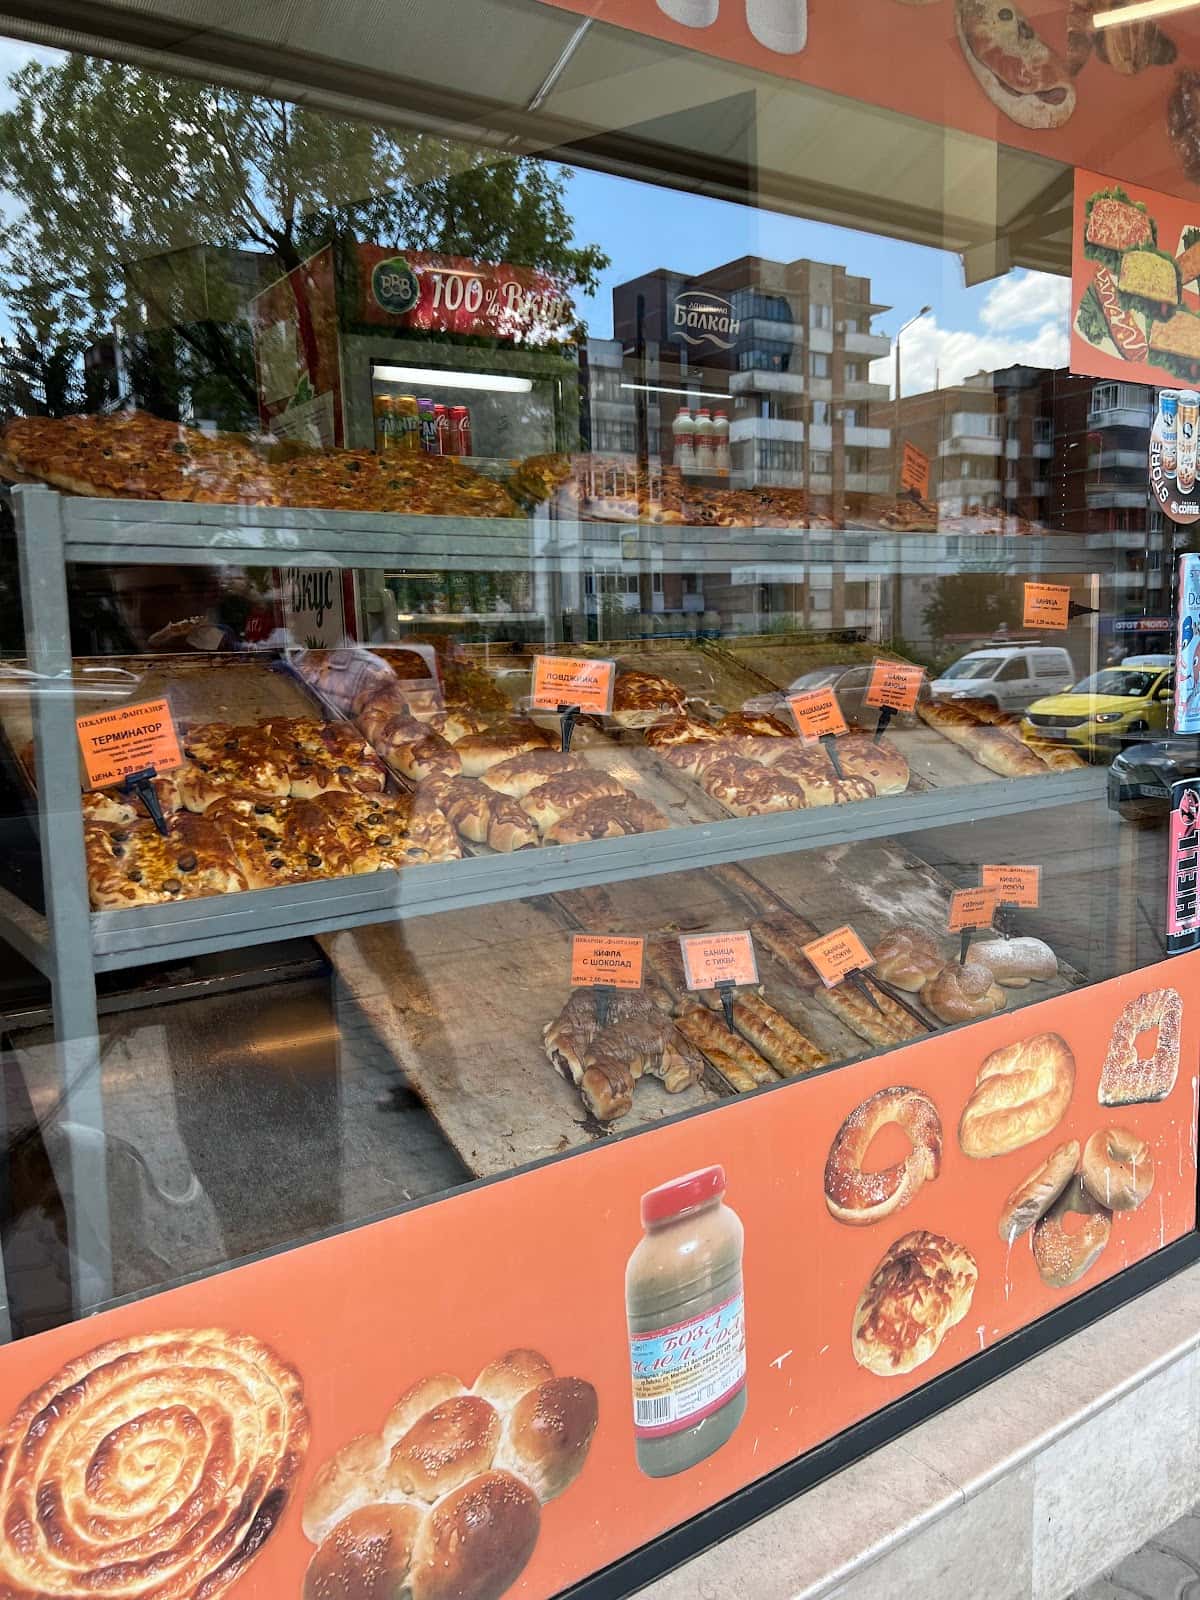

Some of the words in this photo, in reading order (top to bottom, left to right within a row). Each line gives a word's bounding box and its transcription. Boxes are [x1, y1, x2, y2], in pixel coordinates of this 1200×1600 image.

[673, 303, 740, 334] Балкан
[1151, 442, 1169, 502] STORE
[78, 714, 117, 728] ПЕКАРНИ
[91, 722, 162, 746] ТЕРМИНАТОР
[1175, 829, 1200, 922] HELL
[593, 949, 622, 958] КИФЛА
[703, 948, 735, 957] БАНИЦА
[712, 957, 736, 966] ТИКВА
[582, 958, 589, 966] С
[590, 959, 632, 969] ШОКОЛАД
[663, 1315, 722, 1353] БОЗА
